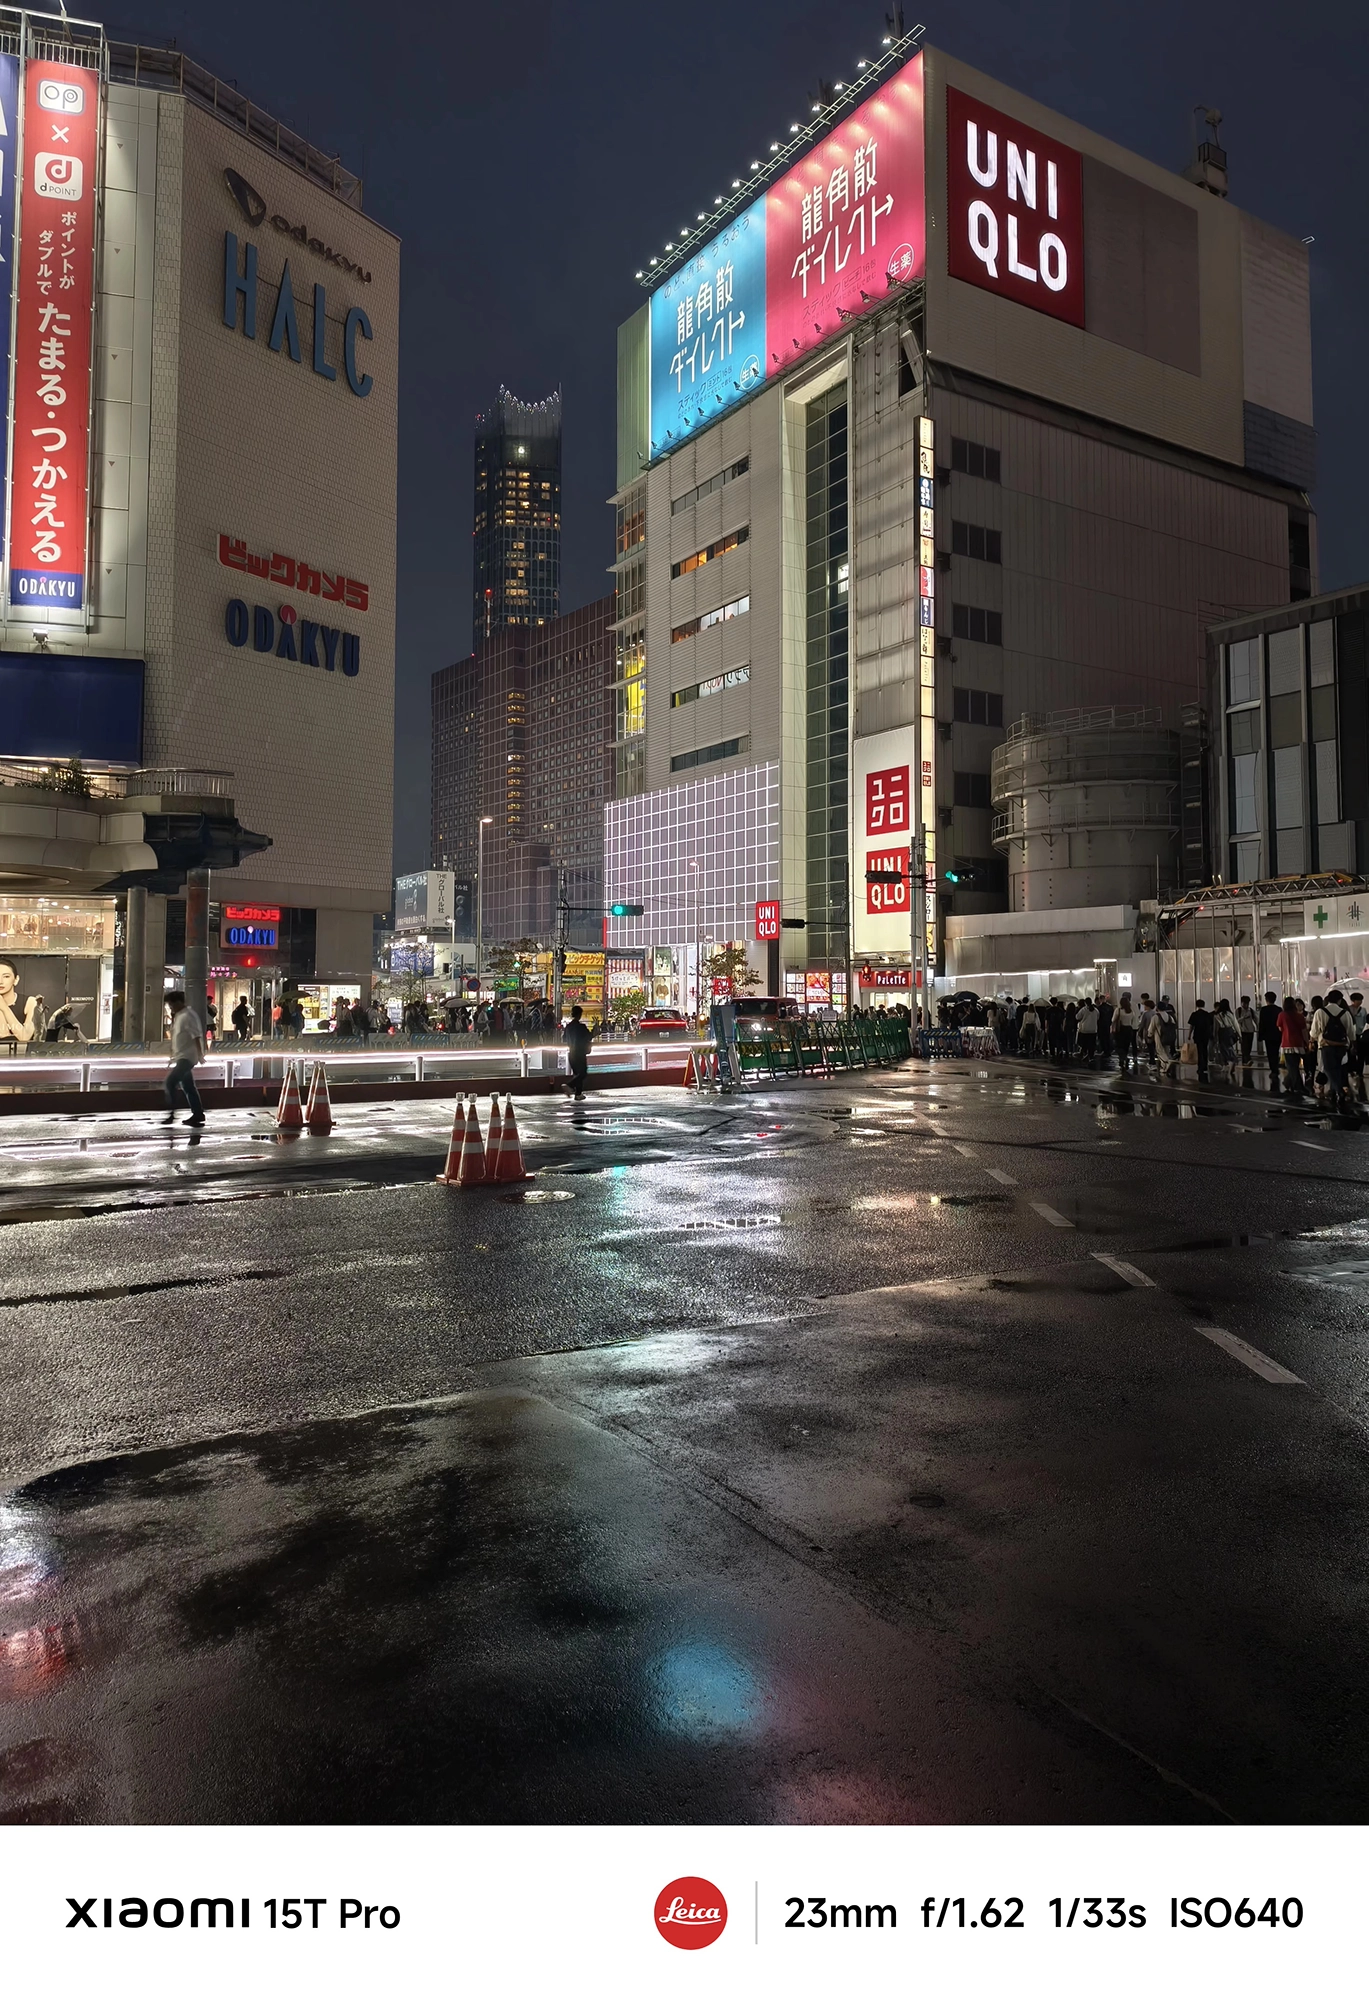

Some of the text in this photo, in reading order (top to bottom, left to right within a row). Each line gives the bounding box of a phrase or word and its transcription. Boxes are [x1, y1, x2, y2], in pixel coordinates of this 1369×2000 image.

[49, 186, 77, 197] POINT
[801, 137, 878, 244] 龍角散
[966, 120, 1059, 220] UNI
[36, 229, 54, 296] ダブルで
[59, 211, 77, 290] ポイントが
[271, 214, 372, 285] odakyu
[791, 193, 894, 299] ダイレクト
[888, 251, 912, 277] 生薬
[967, 200, 1067, 293] QLO
[223, 230, 373, 397] HALC
[676, 260, 734, 346] 龍角散
[669, 310, 746, 394] ダイレクト
[19, 577, 75, 598] ODAKYU
[218, 534, 369, 612] ビックカメラ
[225, 599, 360, 677] ODAKYU
[871, 775, 904, 801] ユニ
[871, 801, 904, 828] クロ
[226, 907, 280, 922] ビックカメラ
[758, 906, 775, 920] UNI
[758, 921, 776, 936] QLO
[871, 883, 905, 909] QLO
[230, 926, 276, 945] ODAKYU
